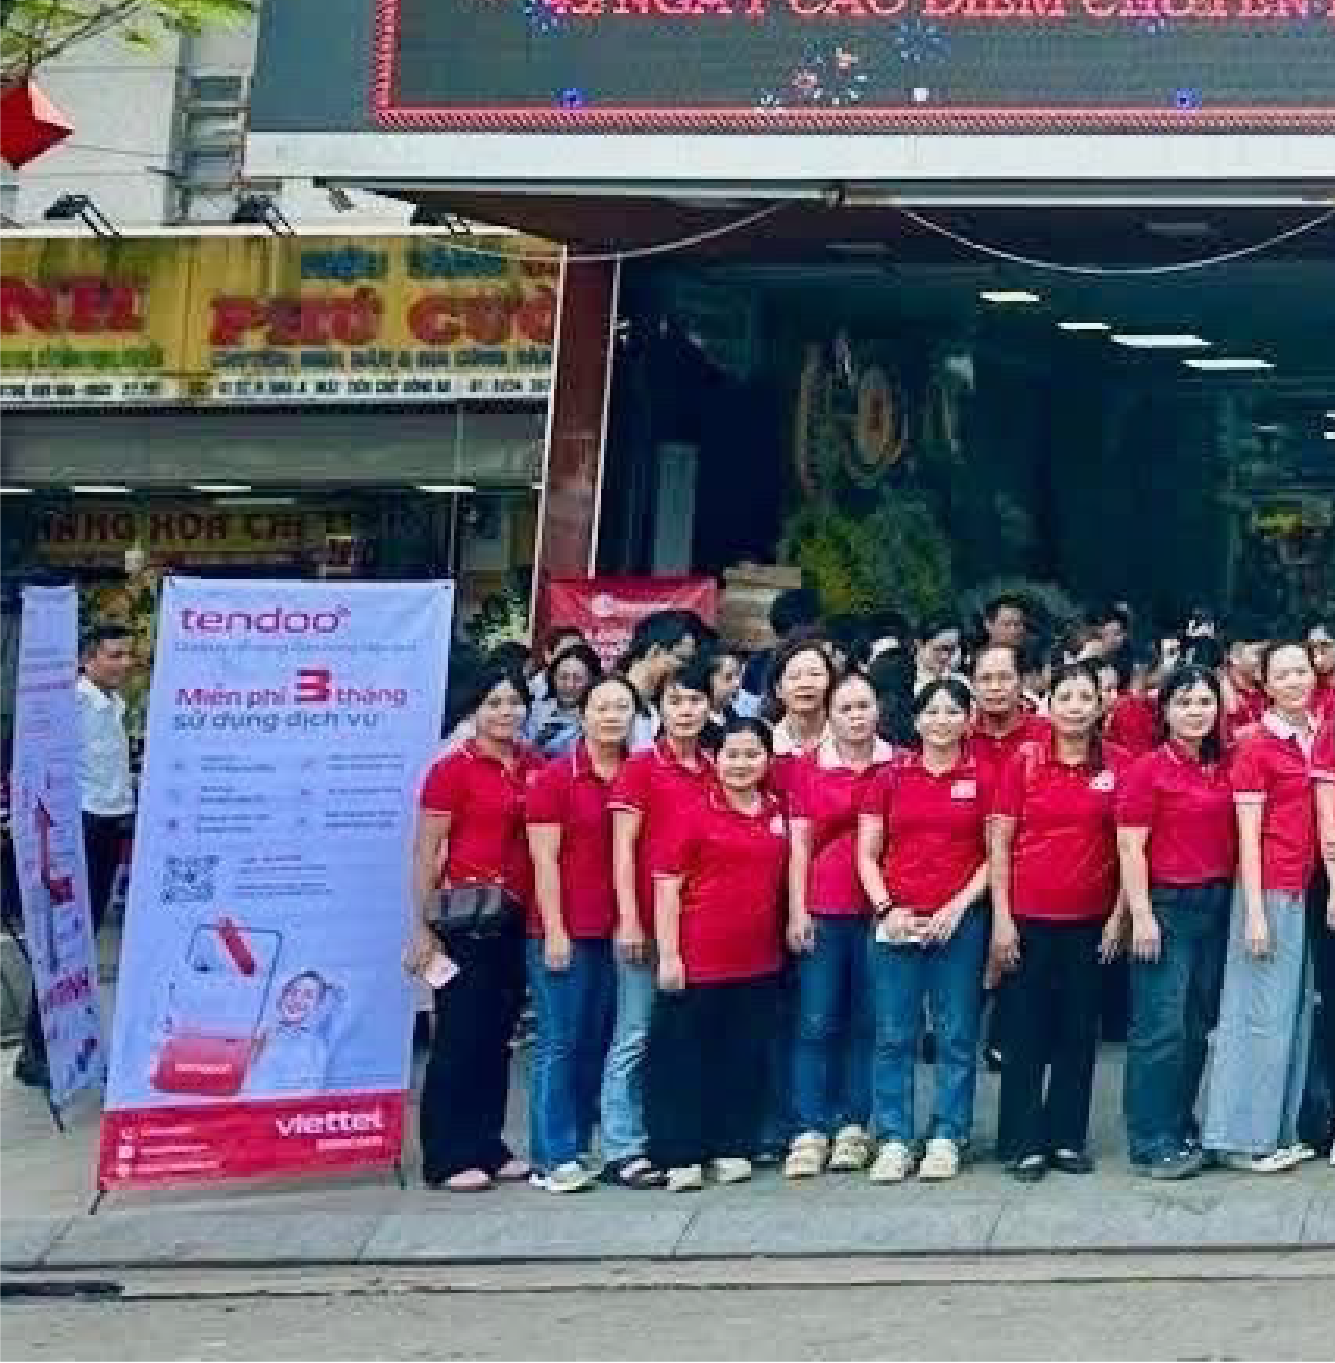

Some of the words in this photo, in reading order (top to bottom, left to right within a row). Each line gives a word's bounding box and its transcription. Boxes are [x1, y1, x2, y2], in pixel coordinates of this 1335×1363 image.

[180, 603, 340, 634] tendoo
[294, 669, 333, 702] 3
[275, 1102, 385, 1137] viettel
